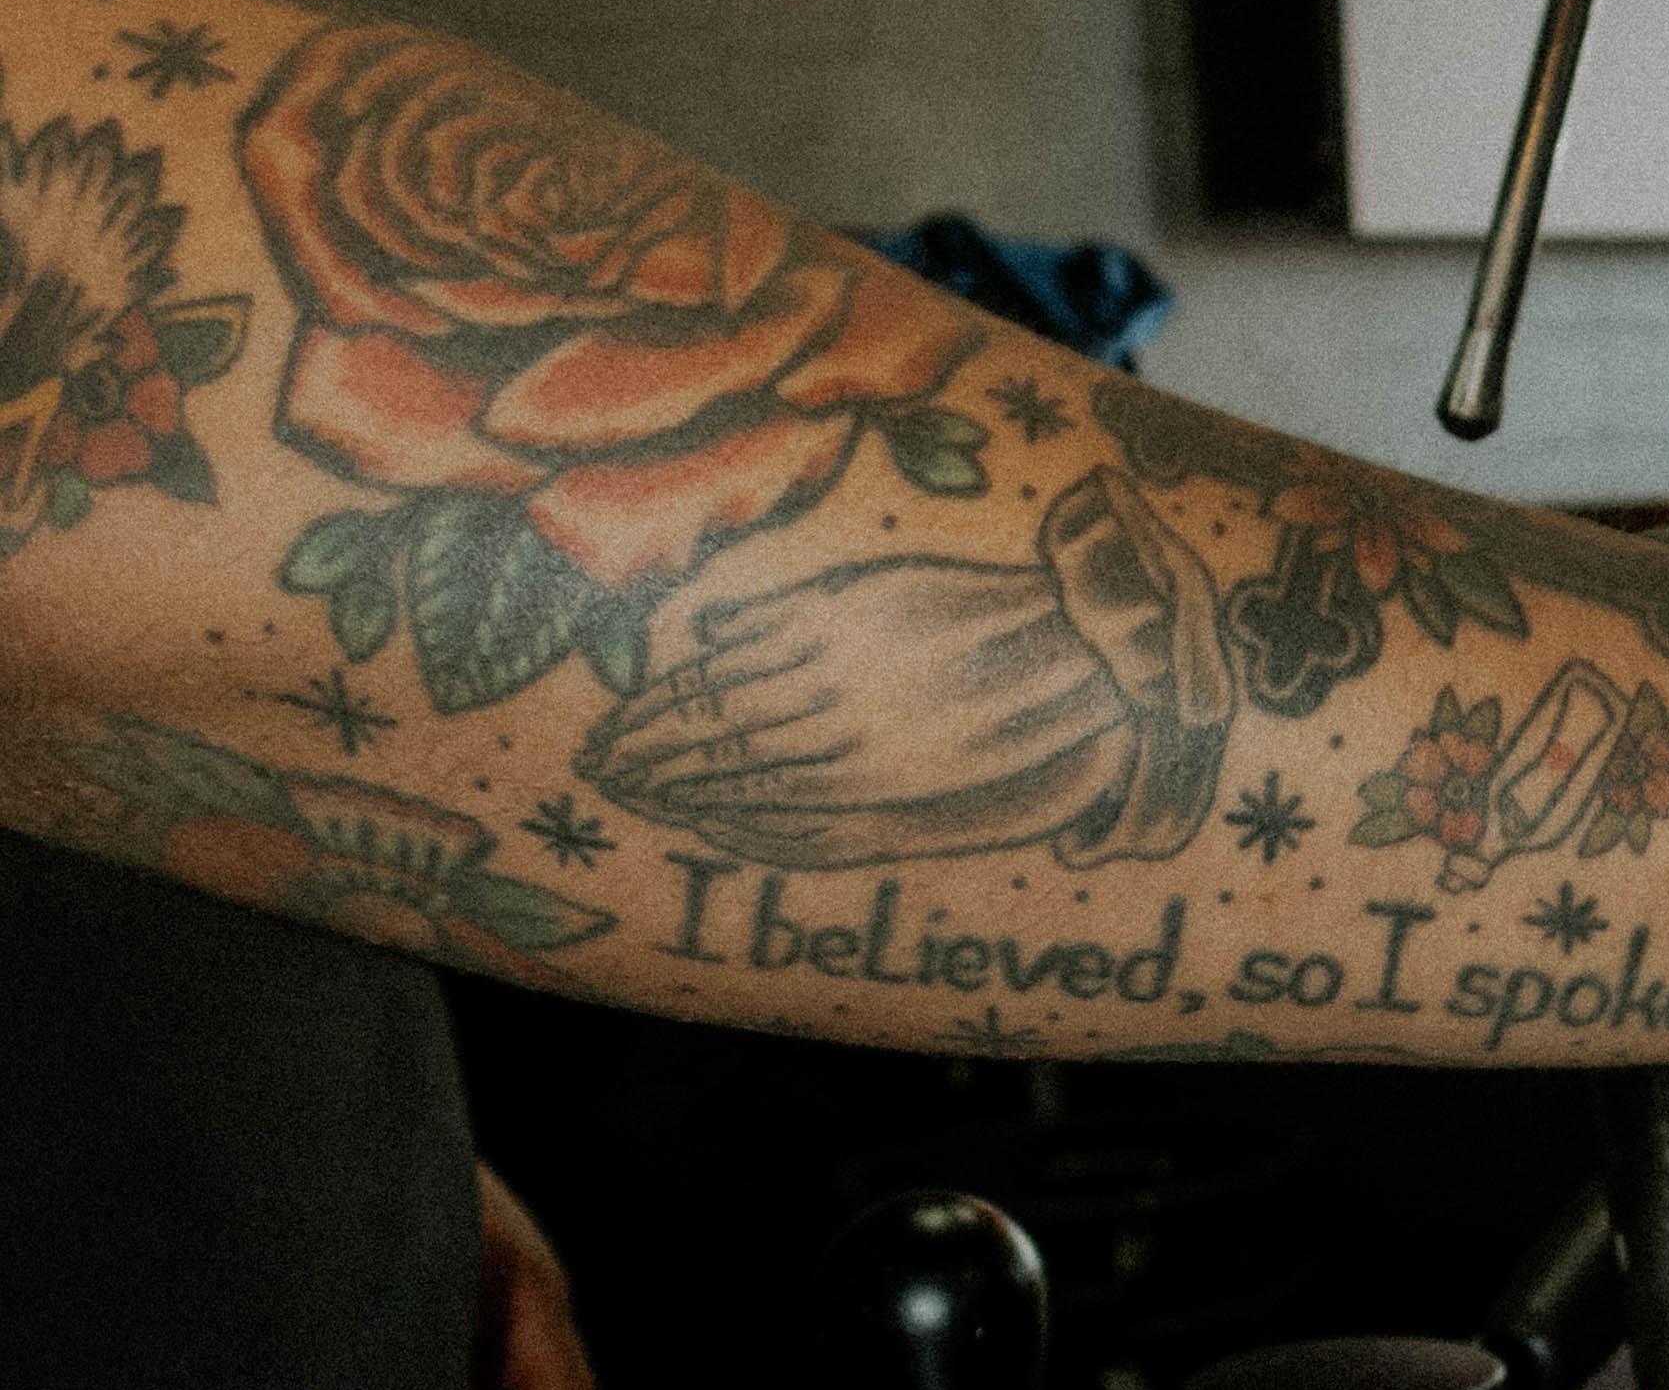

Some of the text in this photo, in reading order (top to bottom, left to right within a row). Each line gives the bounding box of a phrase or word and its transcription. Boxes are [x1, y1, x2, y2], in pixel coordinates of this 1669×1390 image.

[654, 851, 741, 966] I
[1226, 947, 1346, 1008] so
[1354, 898, 1438, 1013] I
